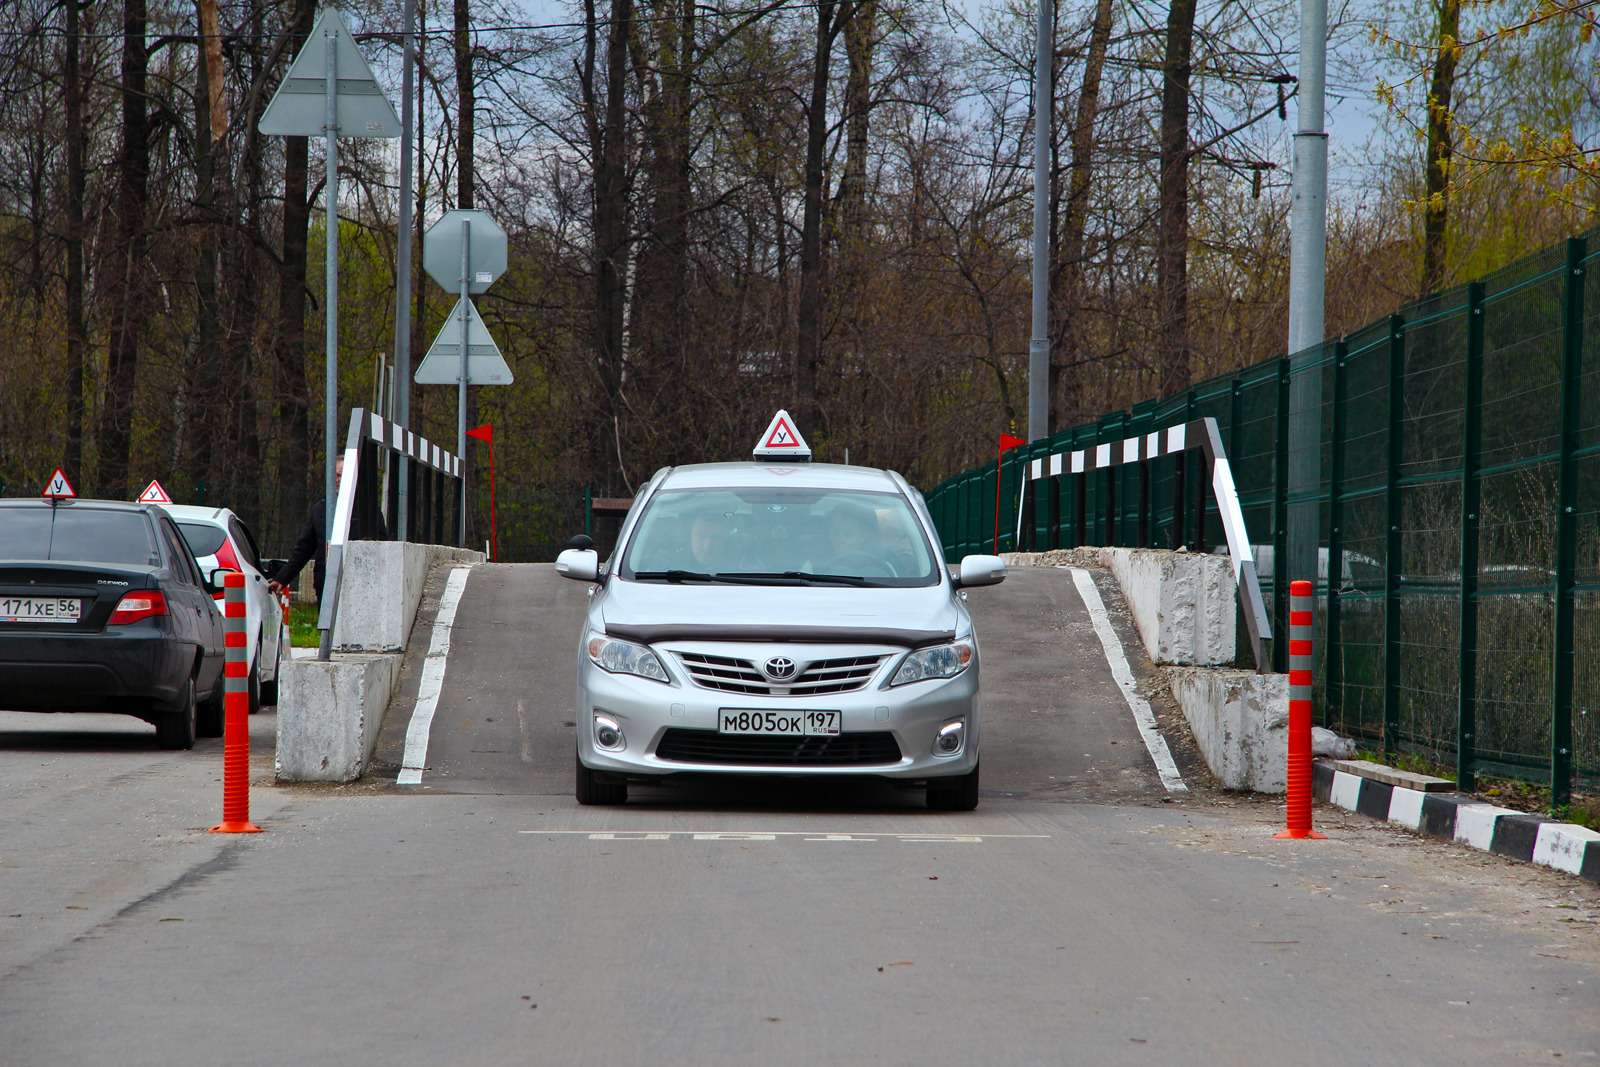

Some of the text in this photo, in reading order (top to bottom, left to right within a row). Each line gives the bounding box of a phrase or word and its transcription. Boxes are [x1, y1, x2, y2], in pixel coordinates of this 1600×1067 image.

[777, 432, 787, 443] У
[54, 479, 63, 493] У
[59, 599, 75, 612] 56
[806, 712, 836, 727] 197
